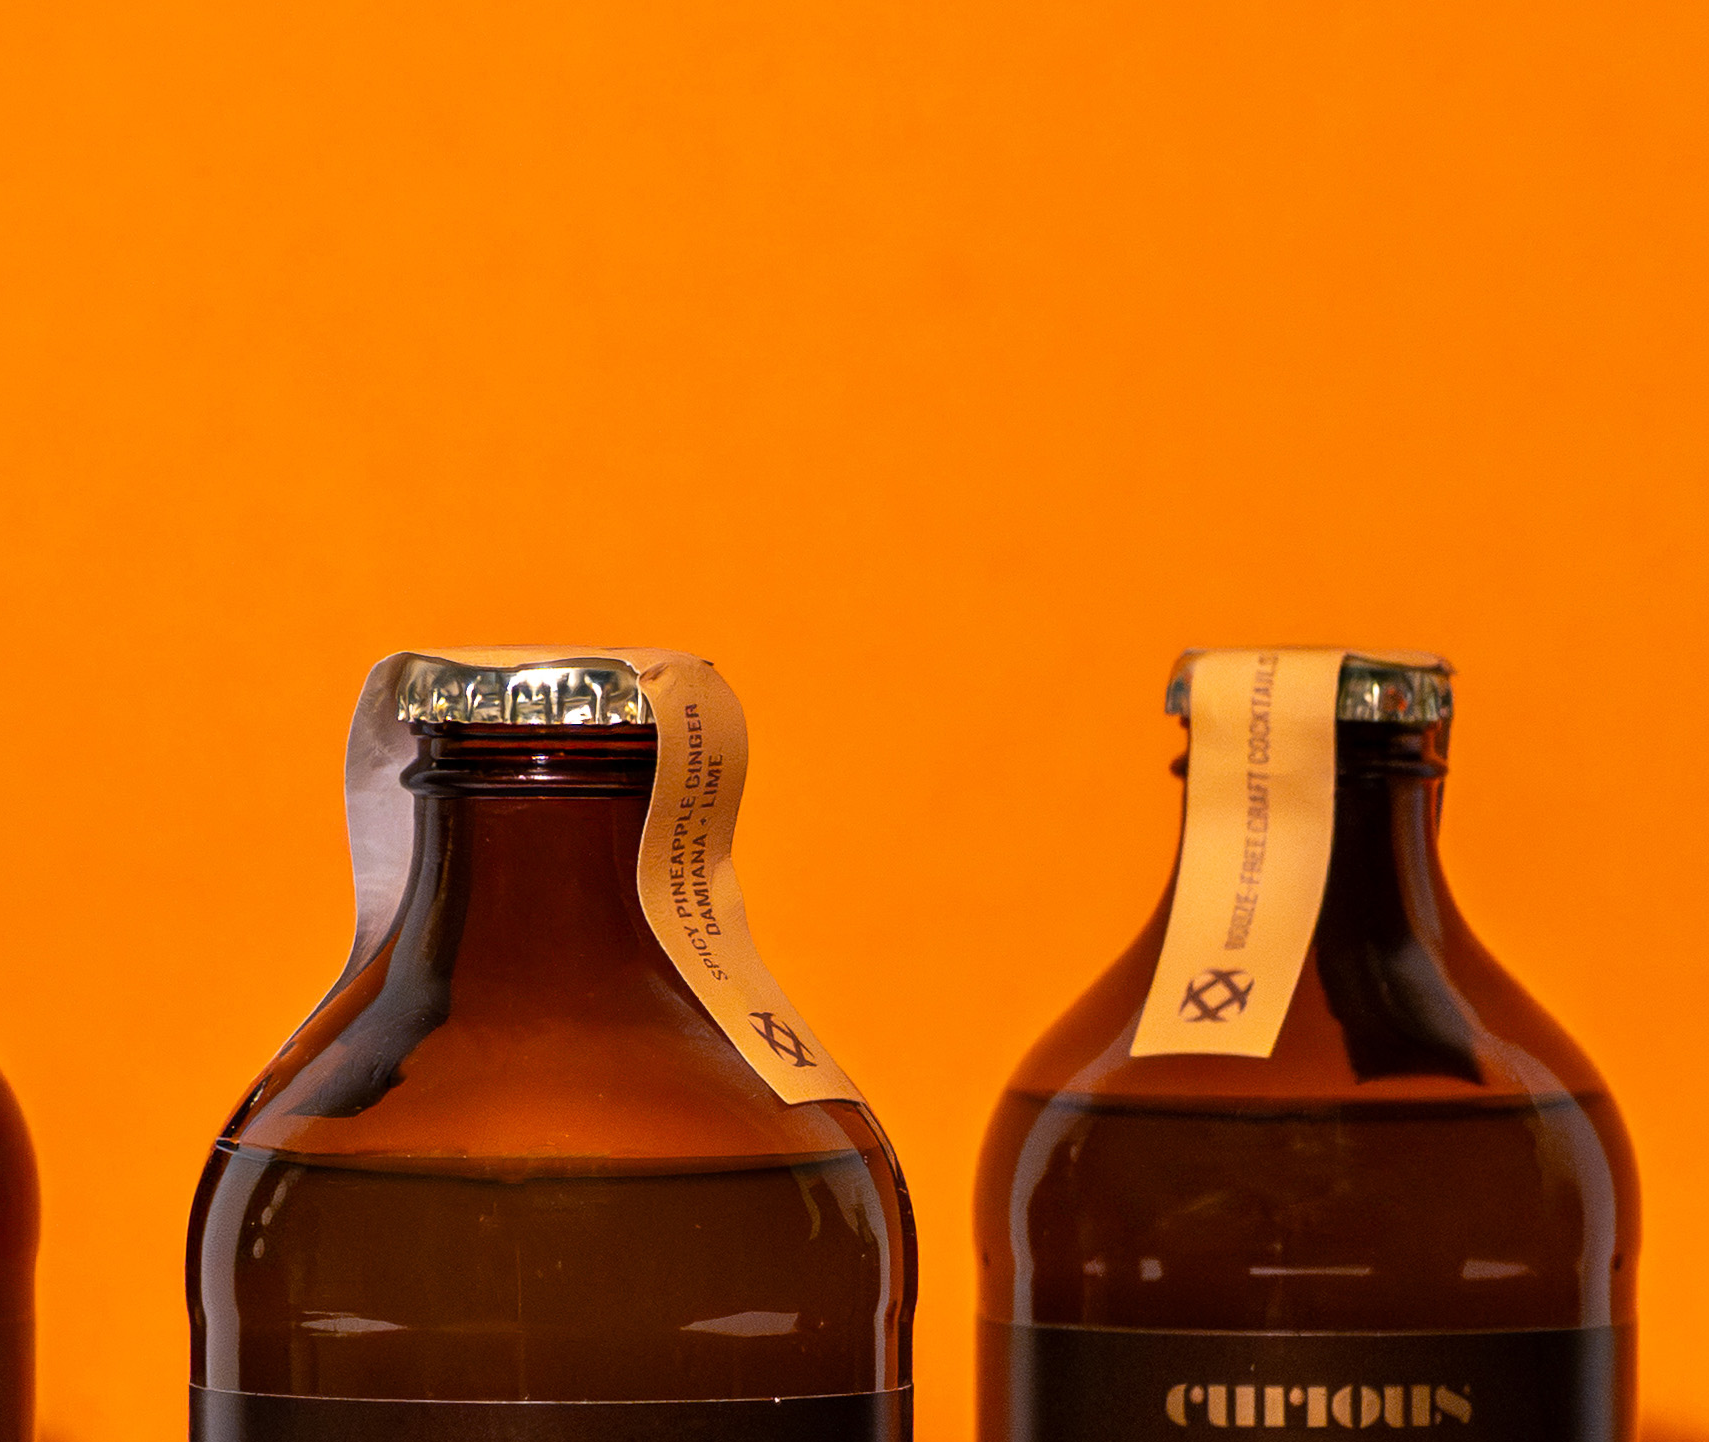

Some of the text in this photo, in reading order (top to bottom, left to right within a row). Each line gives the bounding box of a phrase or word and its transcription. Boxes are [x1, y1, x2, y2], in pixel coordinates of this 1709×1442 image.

[702, 753, 723, 808] LIME
[669, 703, 728, 982] SPICY PINEAPPLE GINGER
[691, 833, 721, 936] DAMIANA
[1166, 1383, 1472, 1430] curious
